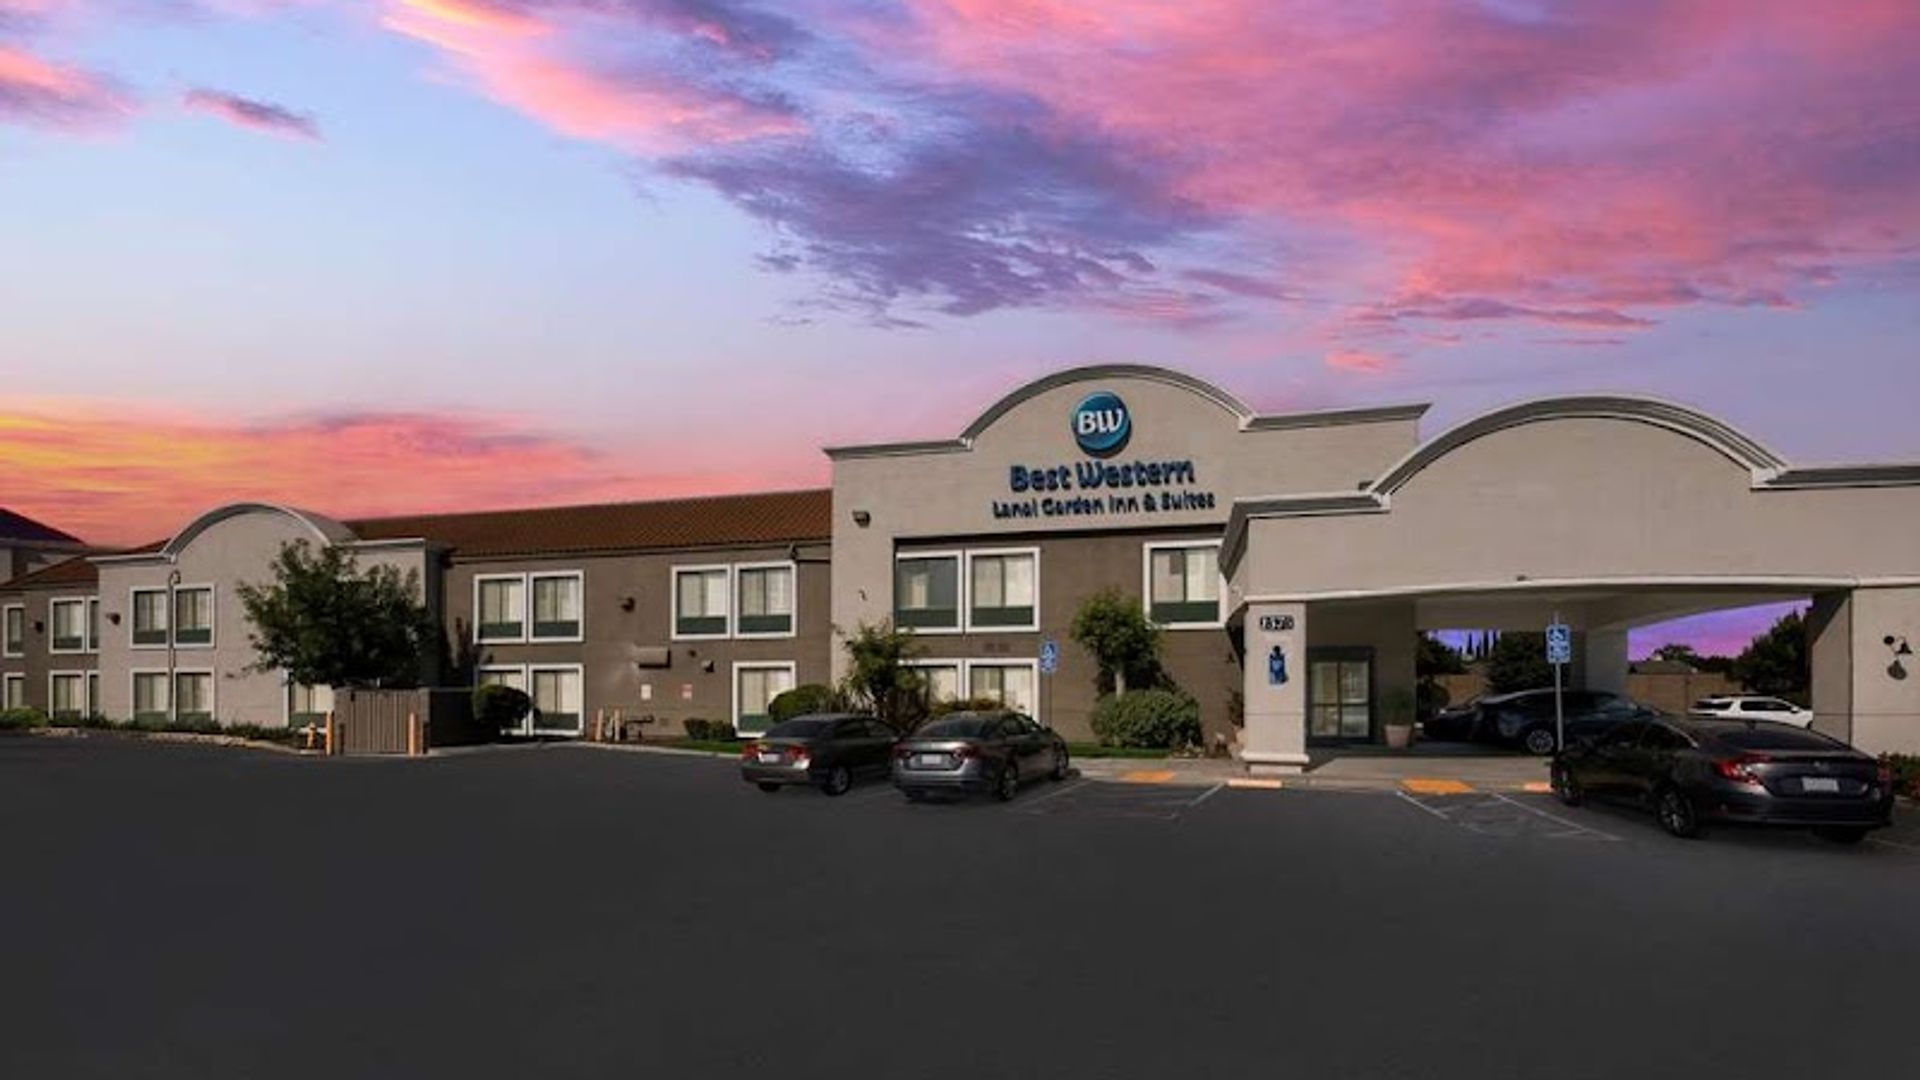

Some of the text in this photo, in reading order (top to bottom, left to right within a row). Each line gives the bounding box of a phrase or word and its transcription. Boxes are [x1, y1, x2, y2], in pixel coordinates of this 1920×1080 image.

[1077, 410, 1123, 435] BW
[1010, 461, 1195, 493] Best Western
[1041, 497, 1104, 517] Garden
[1109, 495, 1139, 514] Inn
[1143, 494, 1158, 512] &
[1161, 490, 1215, 510] Suites
